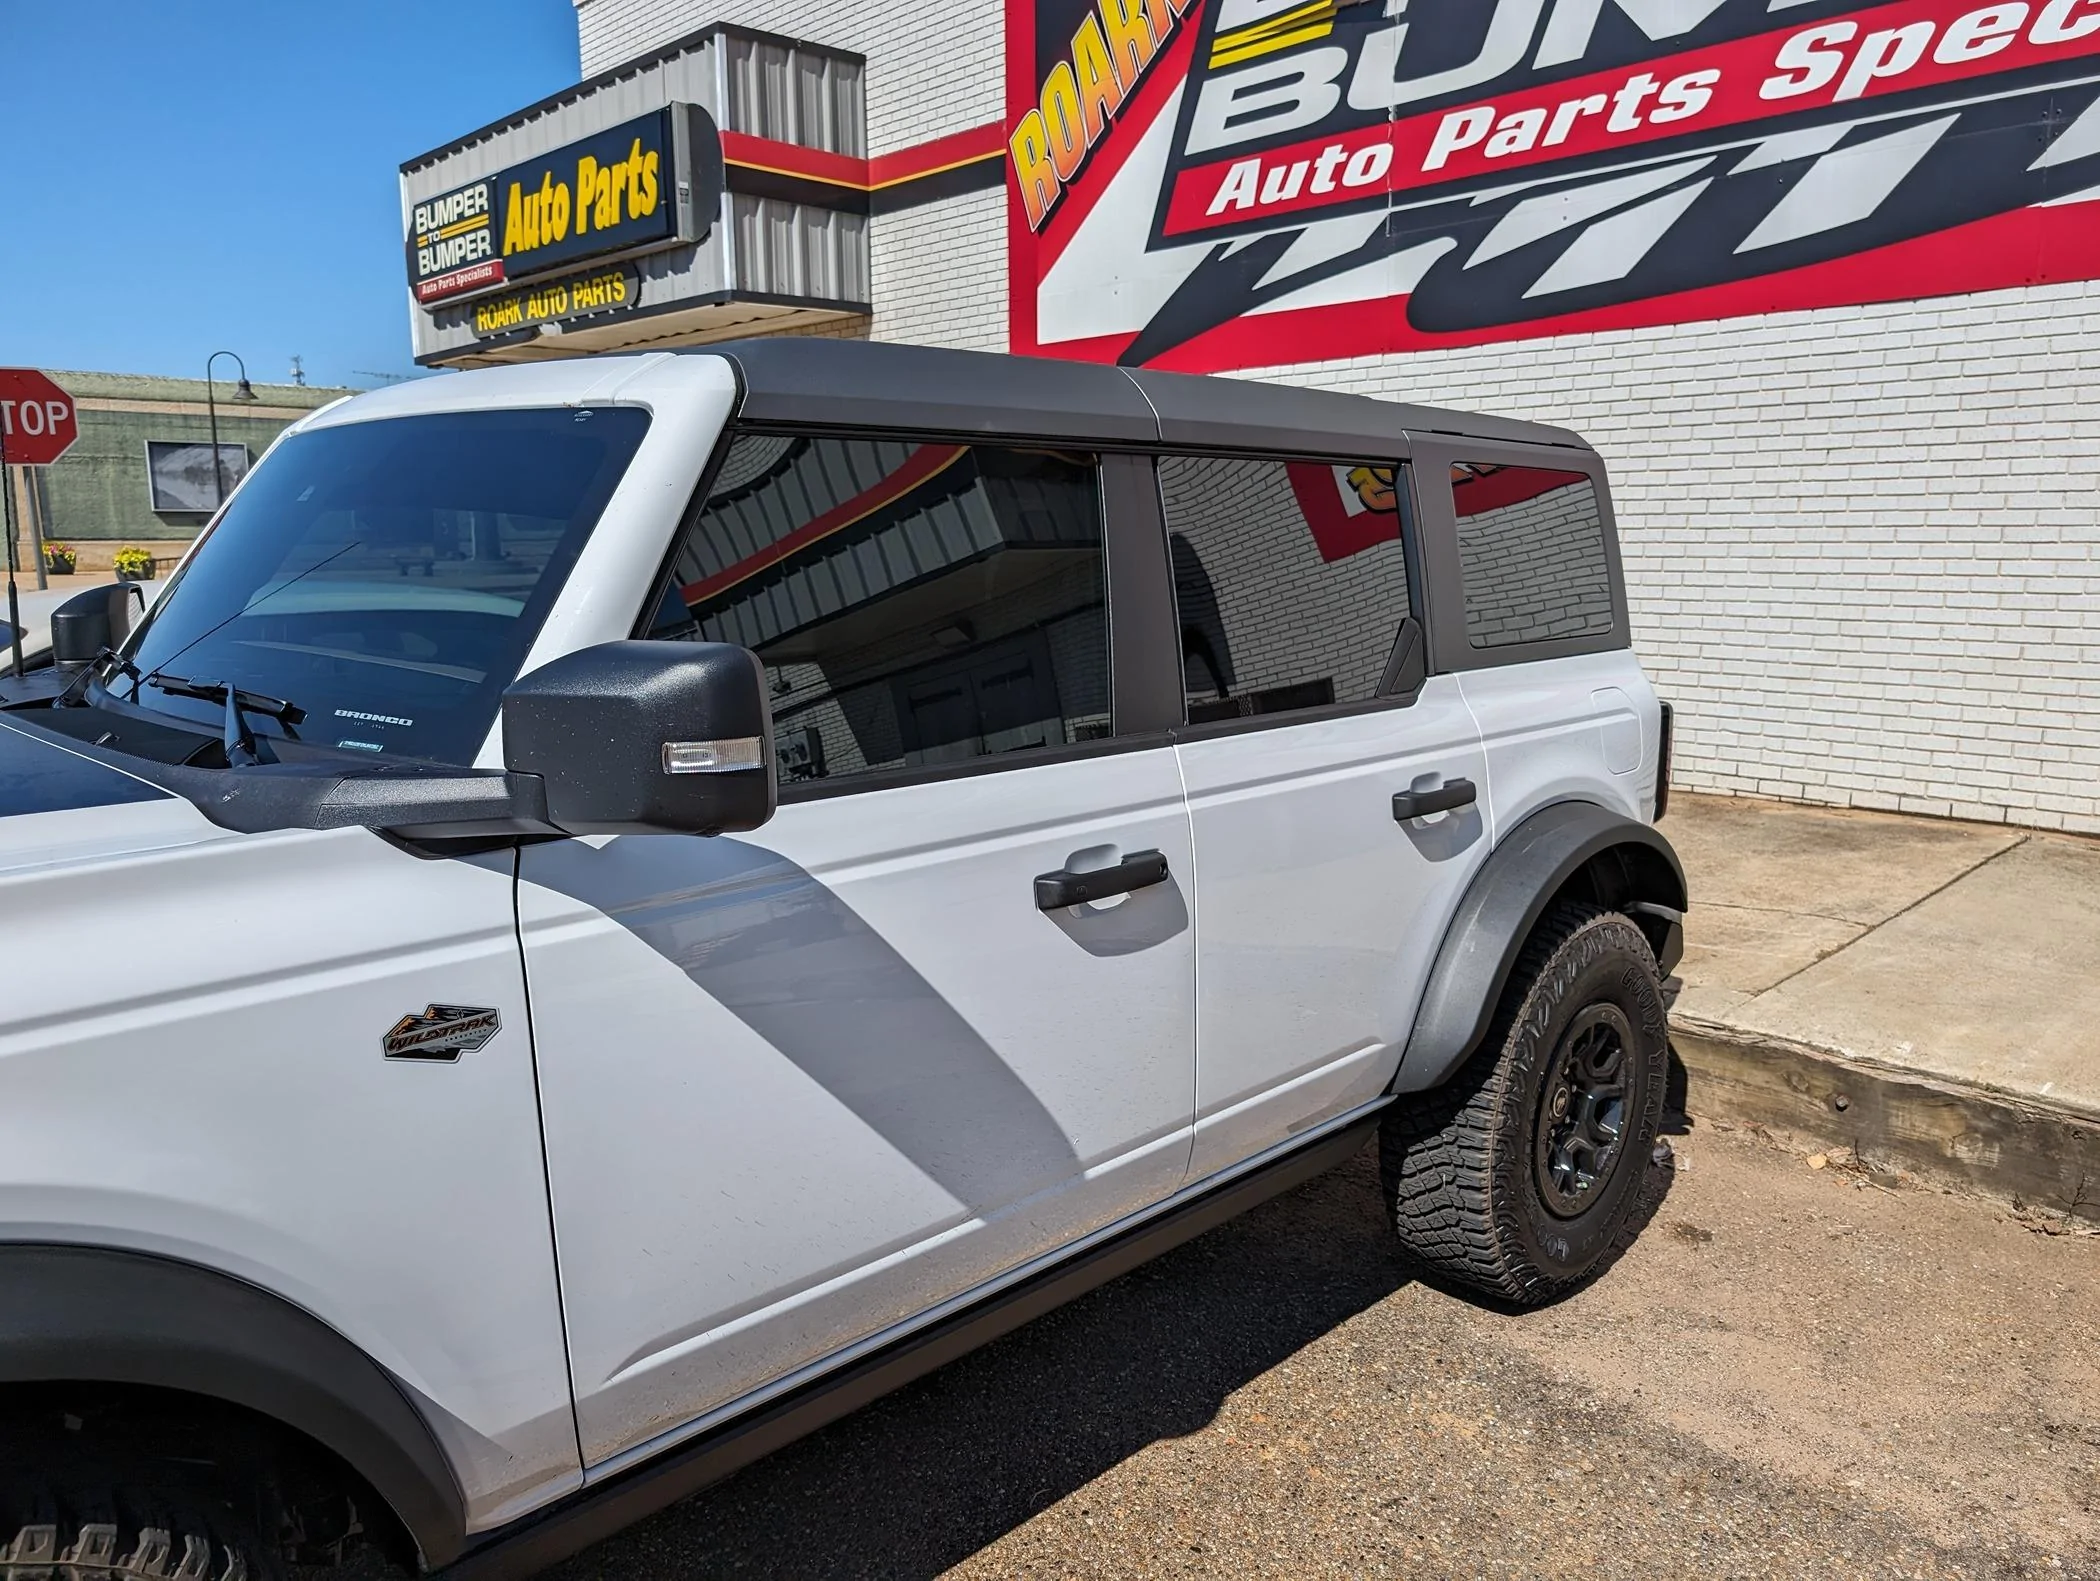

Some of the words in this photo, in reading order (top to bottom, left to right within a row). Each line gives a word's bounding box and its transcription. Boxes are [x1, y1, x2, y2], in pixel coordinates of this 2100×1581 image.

[1205, 142, 1394, 216] Auto
[1421, 68, 1722, 172] Parts
[415, 183, 488, 234] BUMPER
[503, 171, 570, 256] Auto
[576, 137, 659, 235] Parts
[418, 228, 492, 276] BUMPER
[427, 230, 441, 243] TO
[421, 282, 438, 295] Auto
[438, 276, 456, 291] Parts
[456, 265, 493, 287] Specialists
[476, 297, 523, 331] ROARK
[527, 286, 568, 321] AUTO
[572, 271, 626, 310] PARTS
[334, 708, 414, 728] BRONCO
